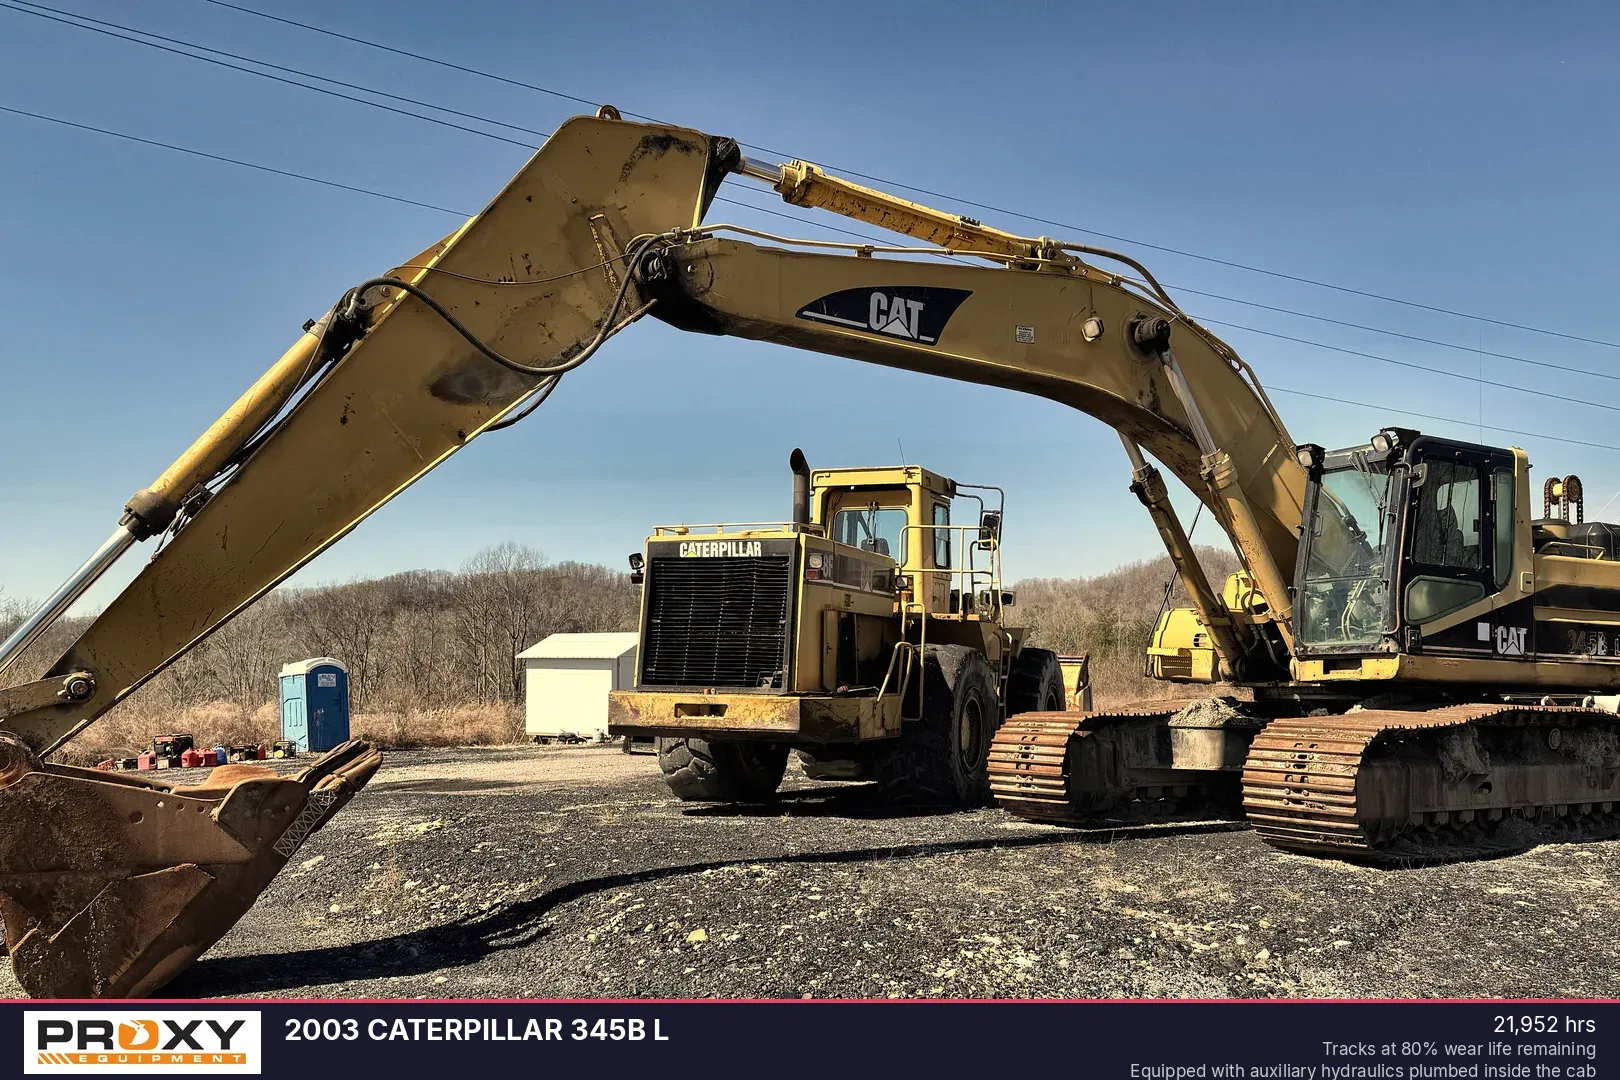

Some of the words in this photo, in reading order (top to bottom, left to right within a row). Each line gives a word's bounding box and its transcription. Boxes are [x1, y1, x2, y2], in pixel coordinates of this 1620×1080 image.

[869, 291, 924, 339] CAT
[679, 541, 762, 558] CATERPILLAR
[1496, 625, 1528, 656] CAT
